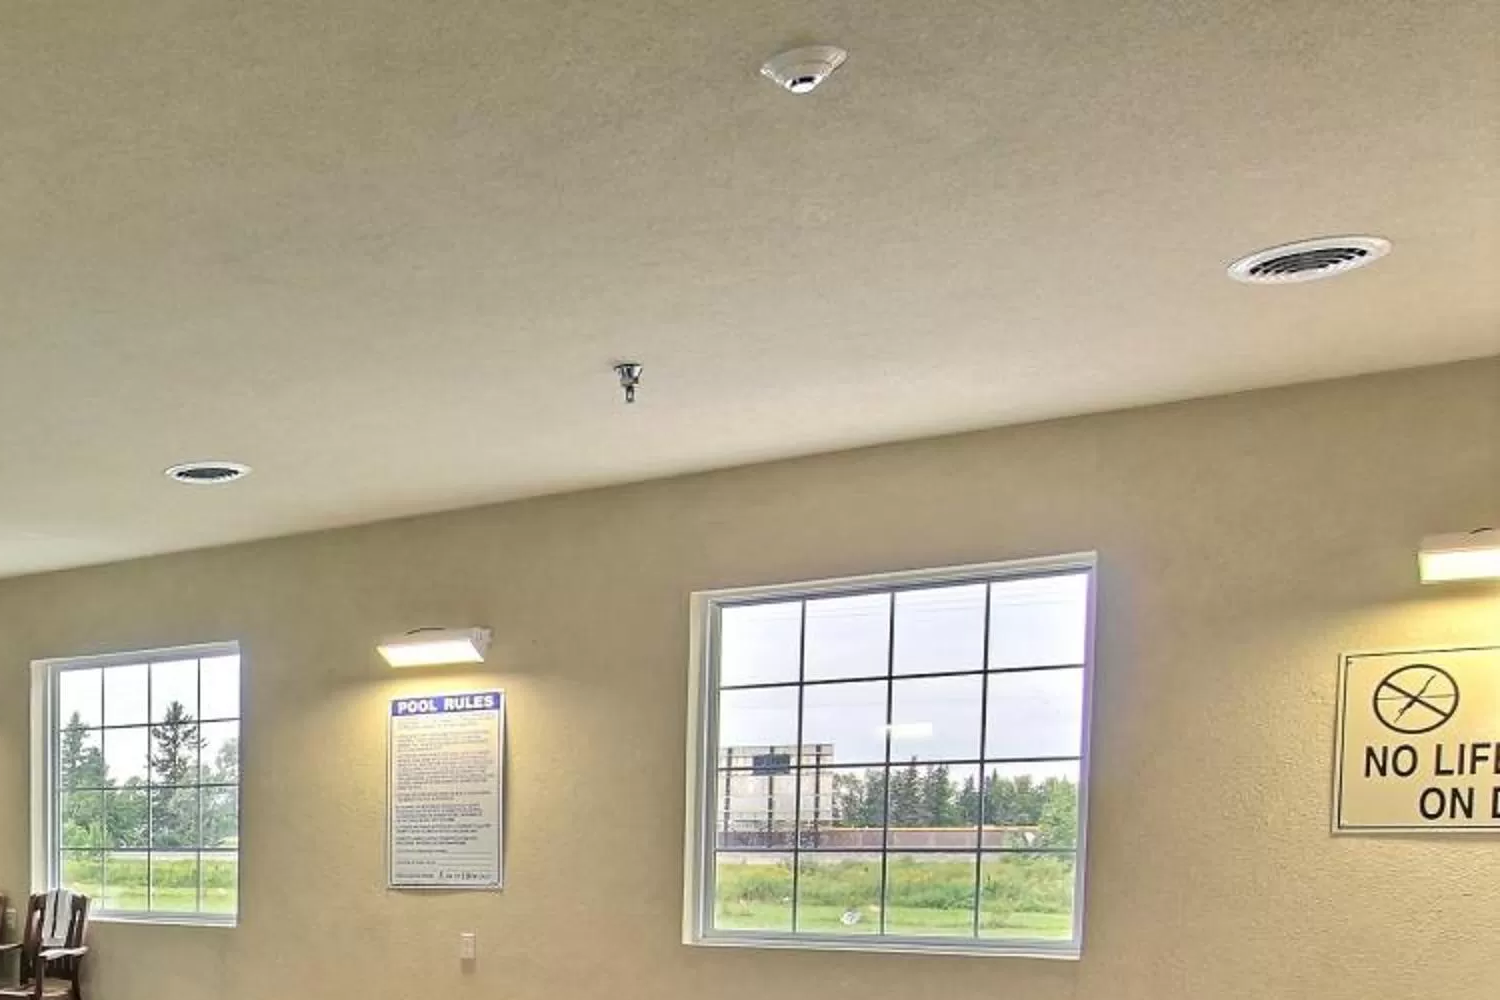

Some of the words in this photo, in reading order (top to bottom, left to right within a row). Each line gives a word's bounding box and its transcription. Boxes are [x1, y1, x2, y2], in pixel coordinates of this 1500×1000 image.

[397, 699, 439, 714] POOL
[443, 695, 495, 711] RULES
[1364, 745, 1418, 778] NO
[1418, 786, 1475, 820] ON
